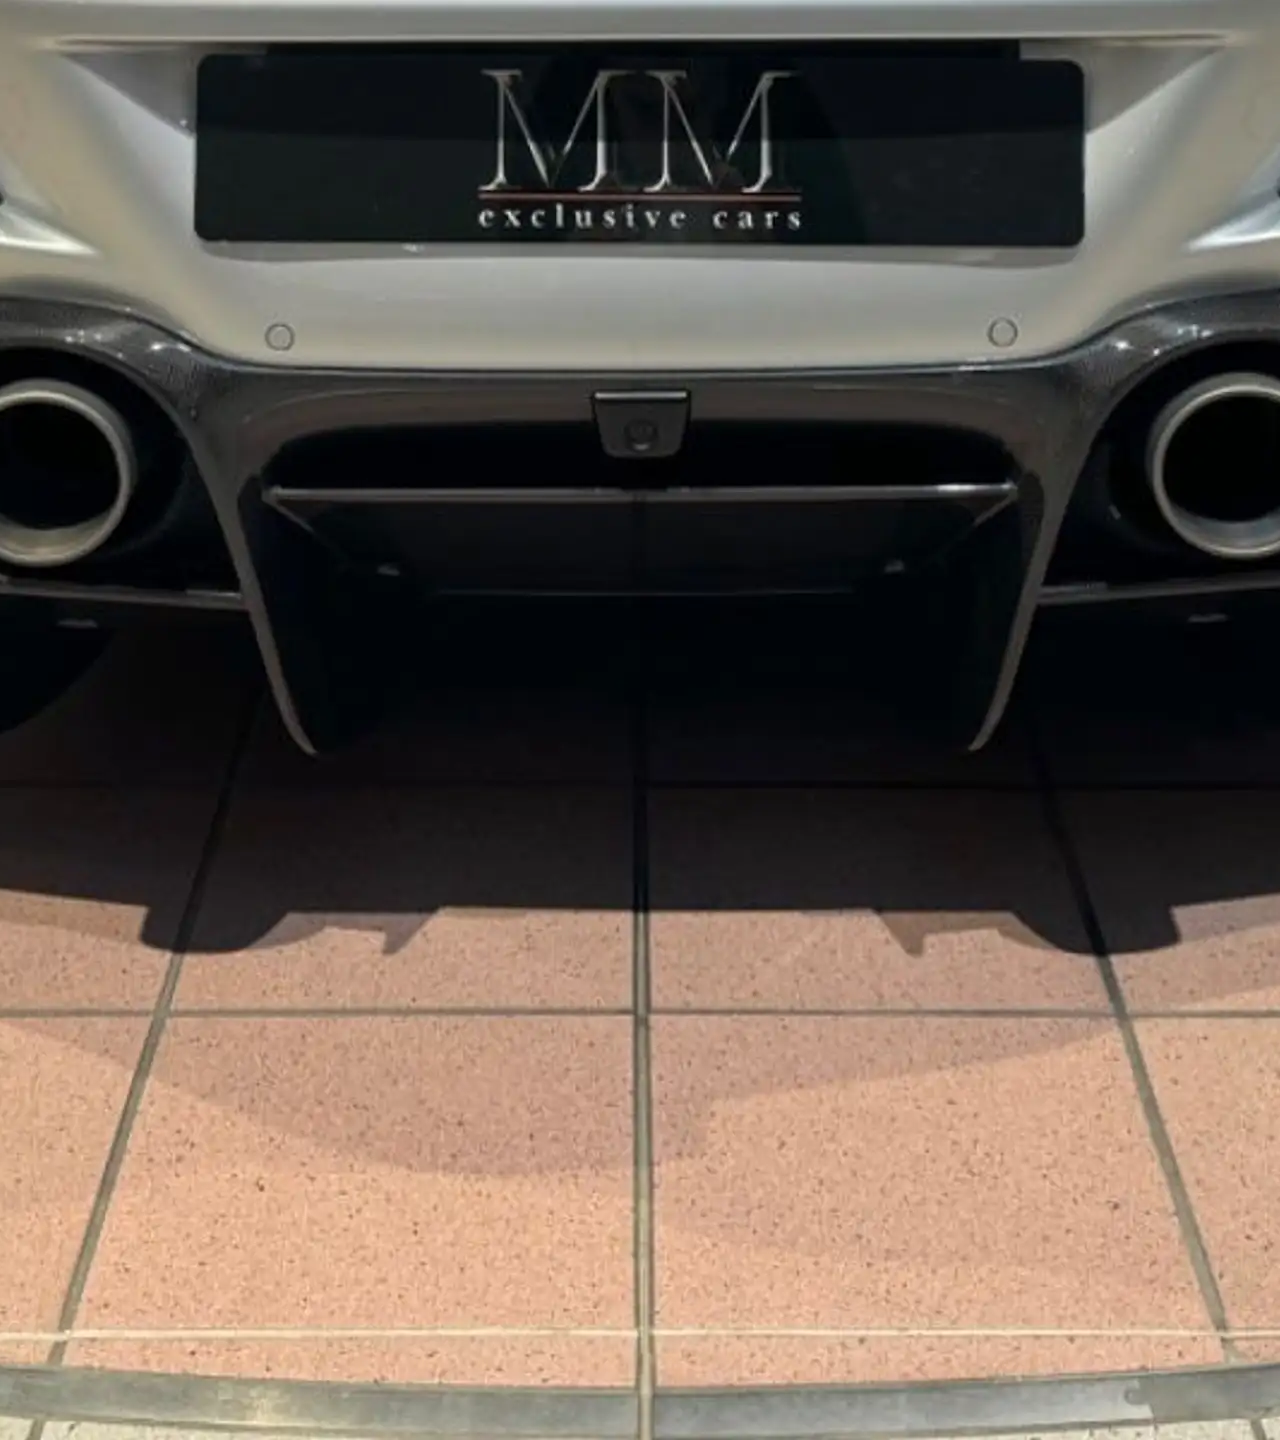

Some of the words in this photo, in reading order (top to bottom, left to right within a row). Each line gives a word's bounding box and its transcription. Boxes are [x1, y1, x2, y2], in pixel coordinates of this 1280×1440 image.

[478, 68, 800, 193] MM
[477, 202, 686, 229] exclusive
[712, 210, 802, 229] cars
